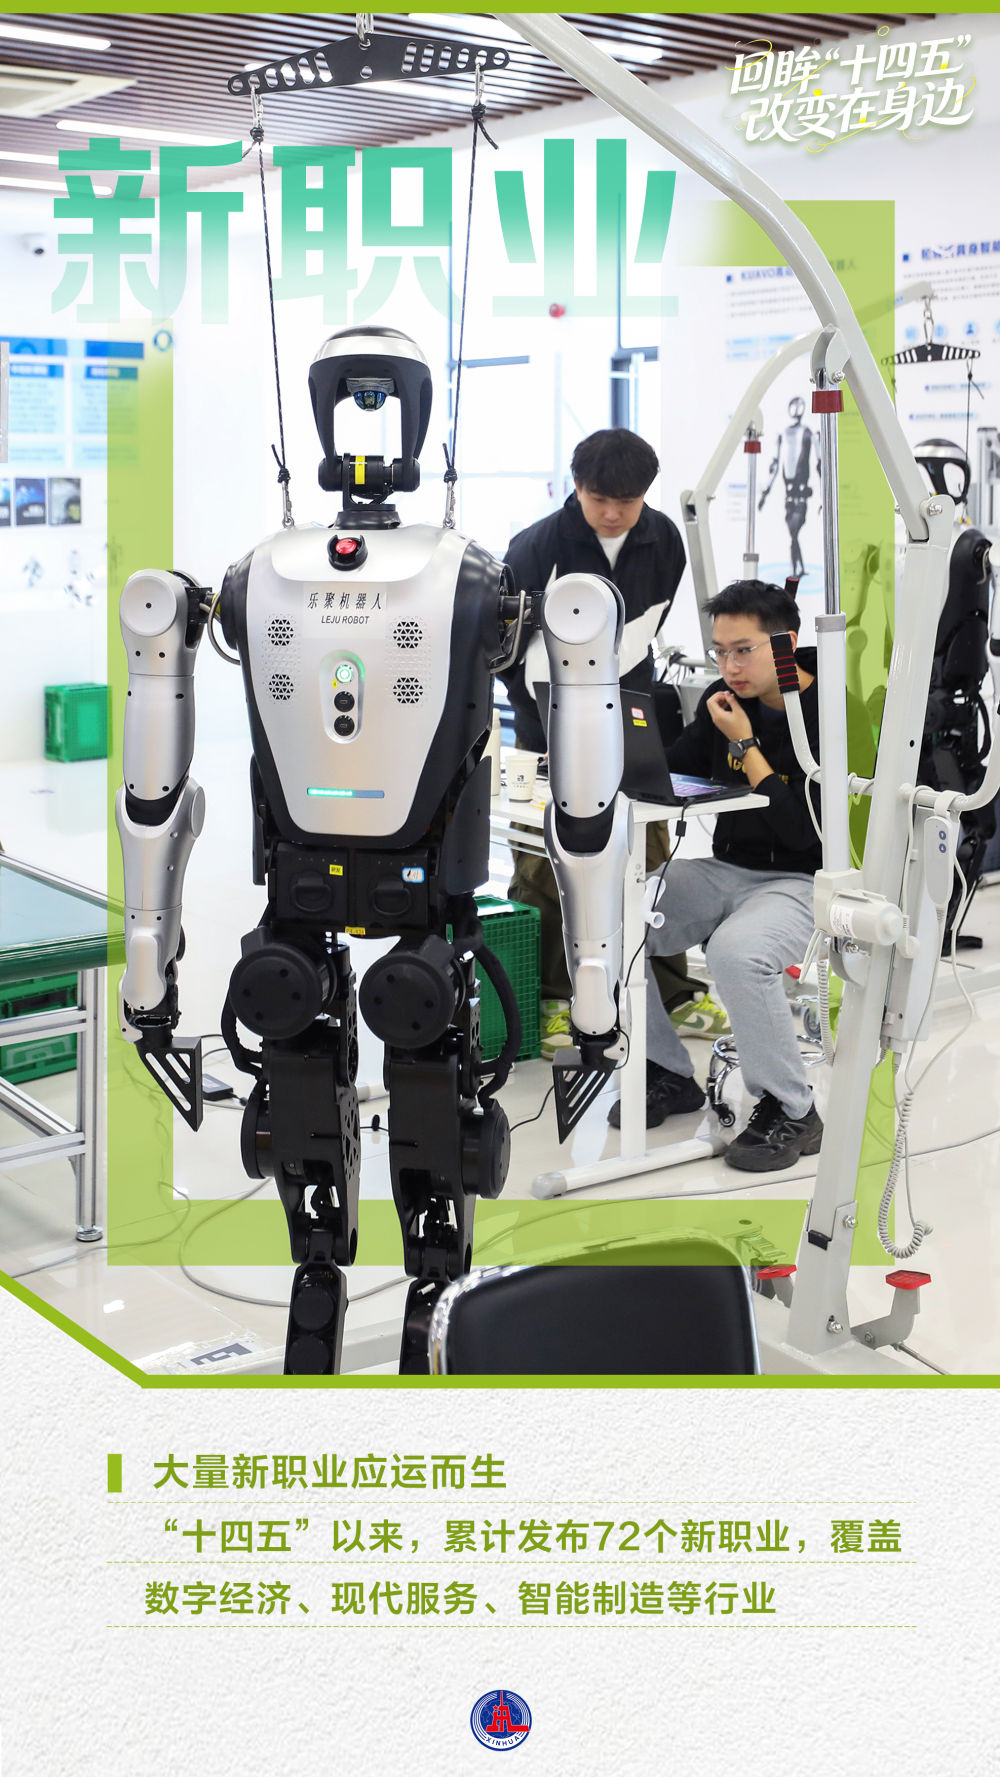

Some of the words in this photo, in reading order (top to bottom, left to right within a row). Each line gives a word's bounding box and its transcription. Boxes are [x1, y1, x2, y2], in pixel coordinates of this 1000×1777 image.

[308, 591, 382, 610] 乐聚机器人
[321, 615, 341, 624] LEJU
[341, 615, 370, 625] ROBOT
